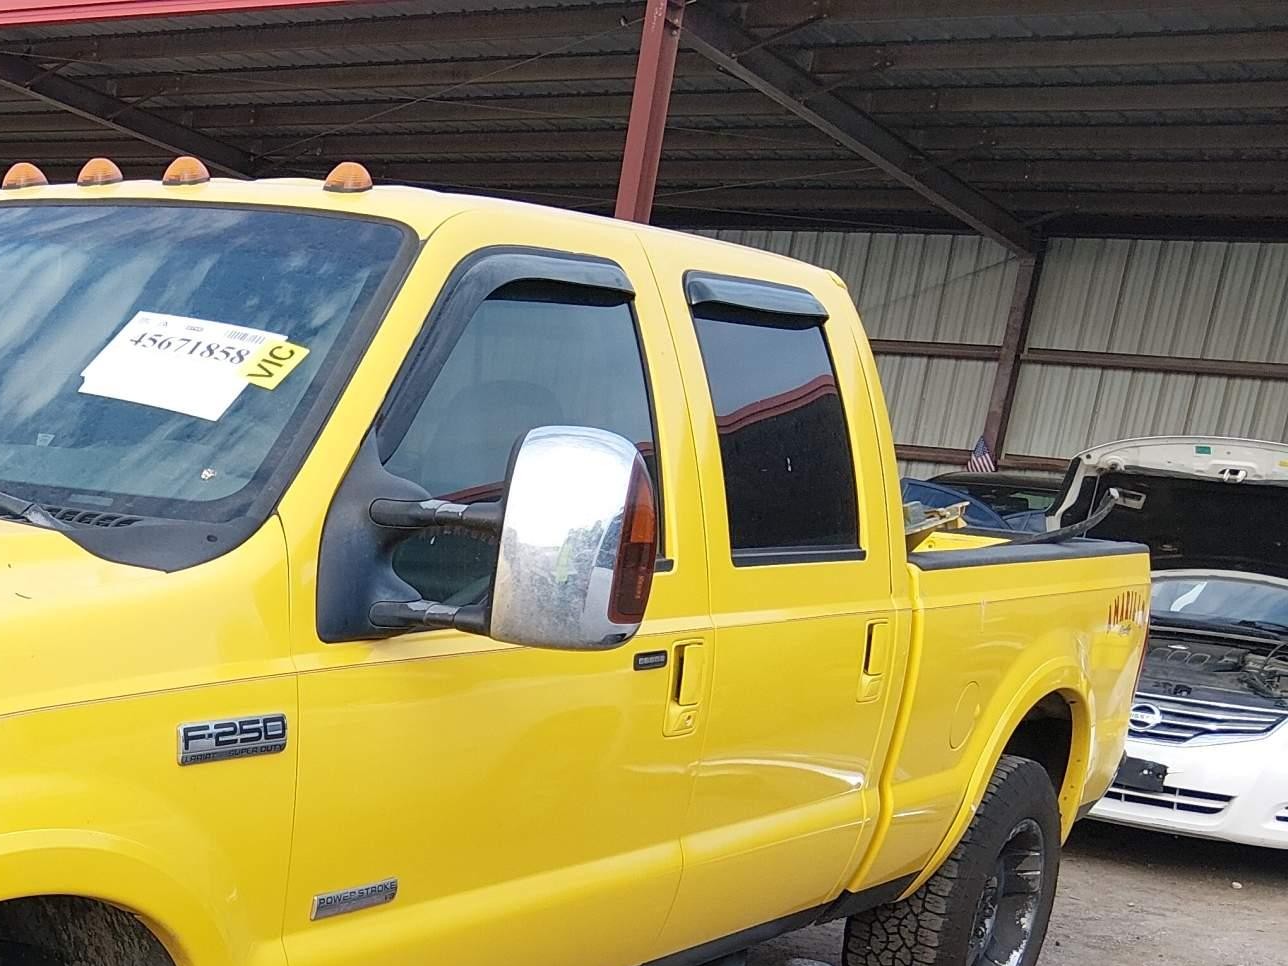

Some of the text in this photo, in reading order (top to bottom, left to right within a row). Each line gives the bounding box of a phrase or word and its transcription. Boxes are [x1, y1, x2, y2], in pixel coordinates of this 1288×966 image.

[130, 332, 251, 365] 45671858
[247, 345, 295, 378] VIC
[183, 716, 286, 751] F-250
